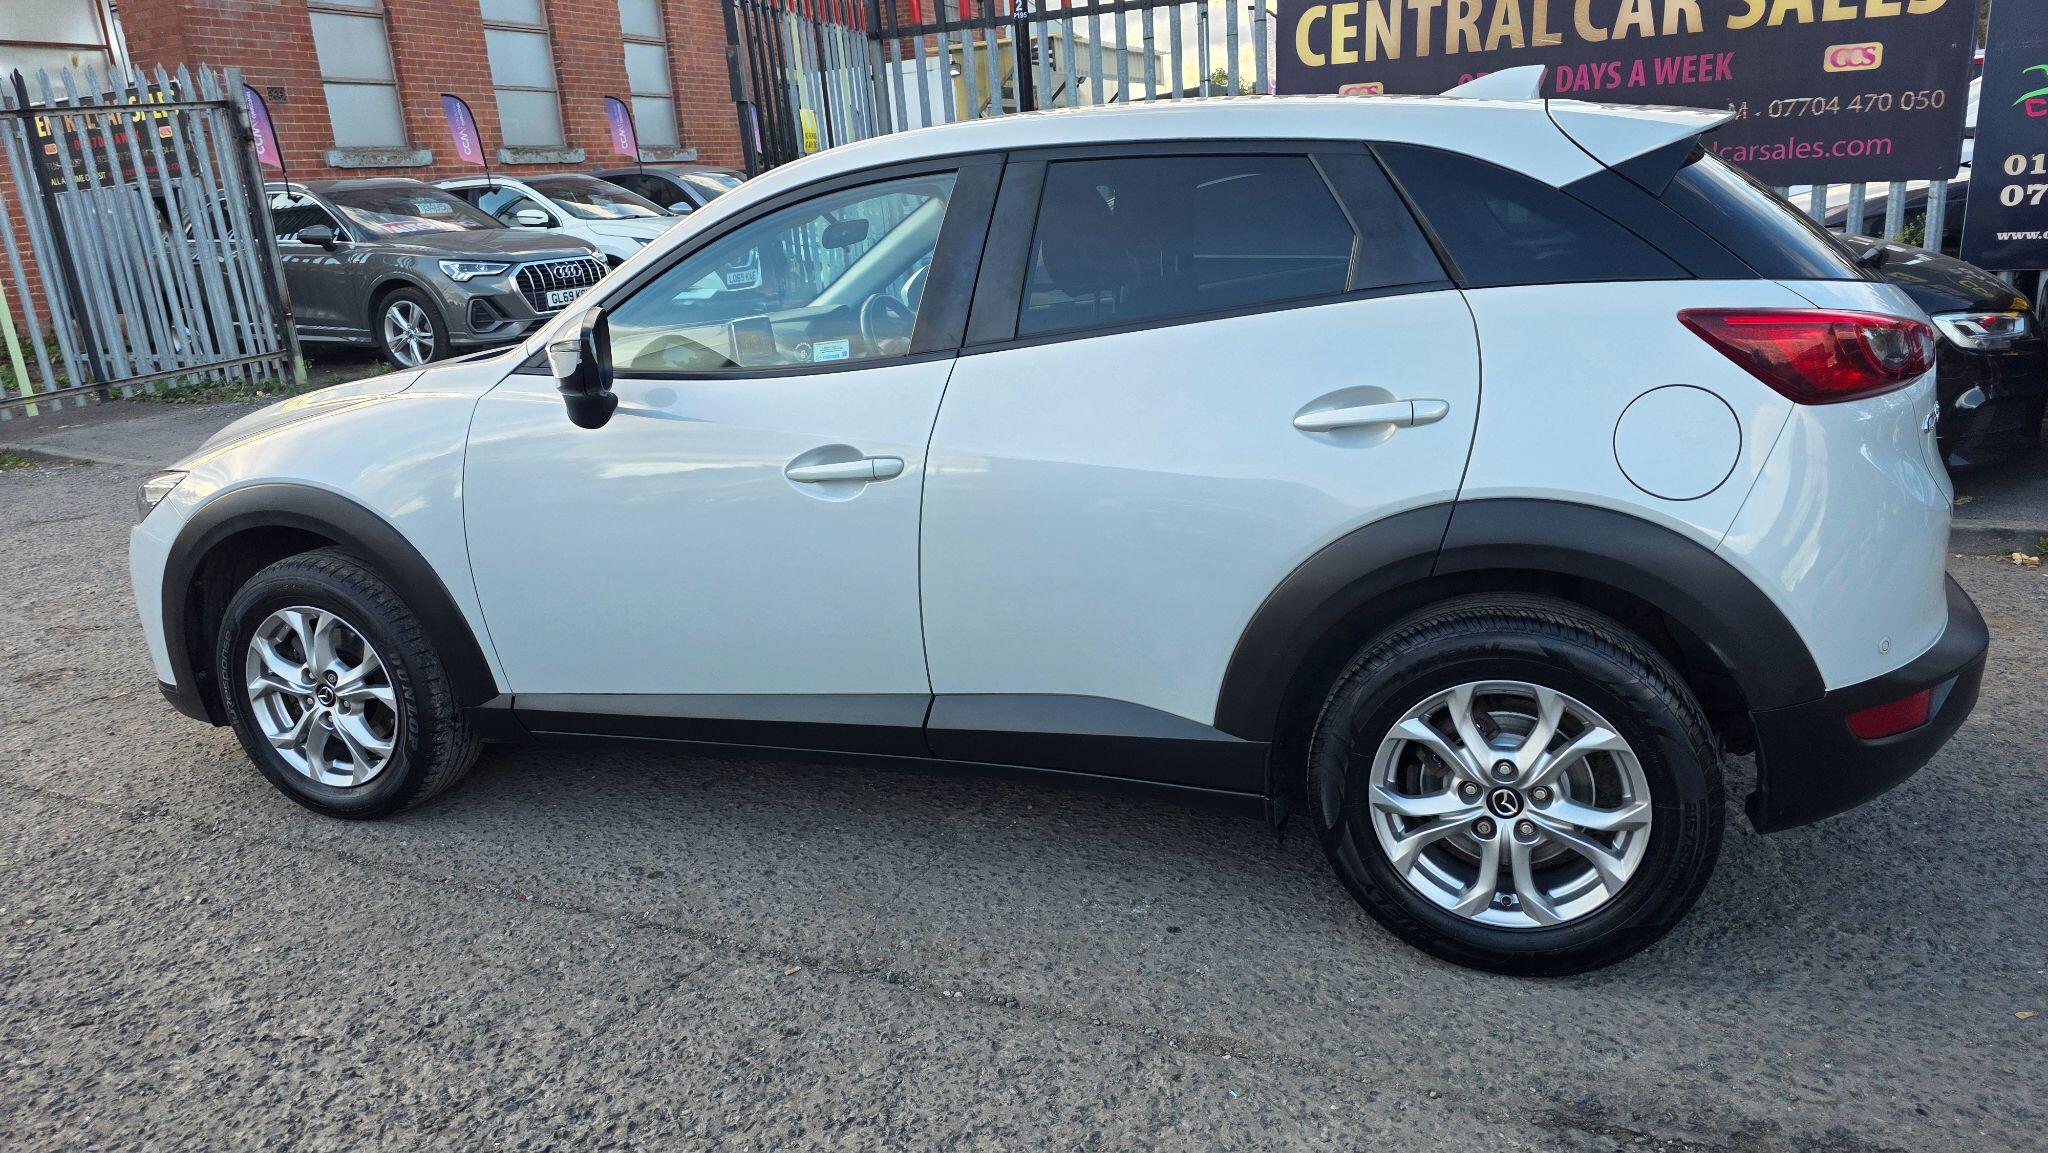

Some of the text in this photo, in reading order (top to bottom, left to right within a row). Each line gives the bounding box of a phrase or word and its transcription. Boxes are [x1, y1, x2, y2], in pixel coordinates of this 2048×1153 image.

[1296, 0, 1562, 67] CENTRAL
[1574, 0, 1703, 42] CAR
[1556, 61, 1621, 93] DAYS
[1628, 59, 1646, 88] A
[1653, 51, 1736, 87] WEEK
[1768, 96, 1840, 119] 07704
[1846, 93, 1893, 112] 470
[1900, 89, 1946, 111] 050
[2004, 153, 2047, 175] 01
[2000, 184, 2048, 207] 07
[551, 291, 574, 304] GL69
